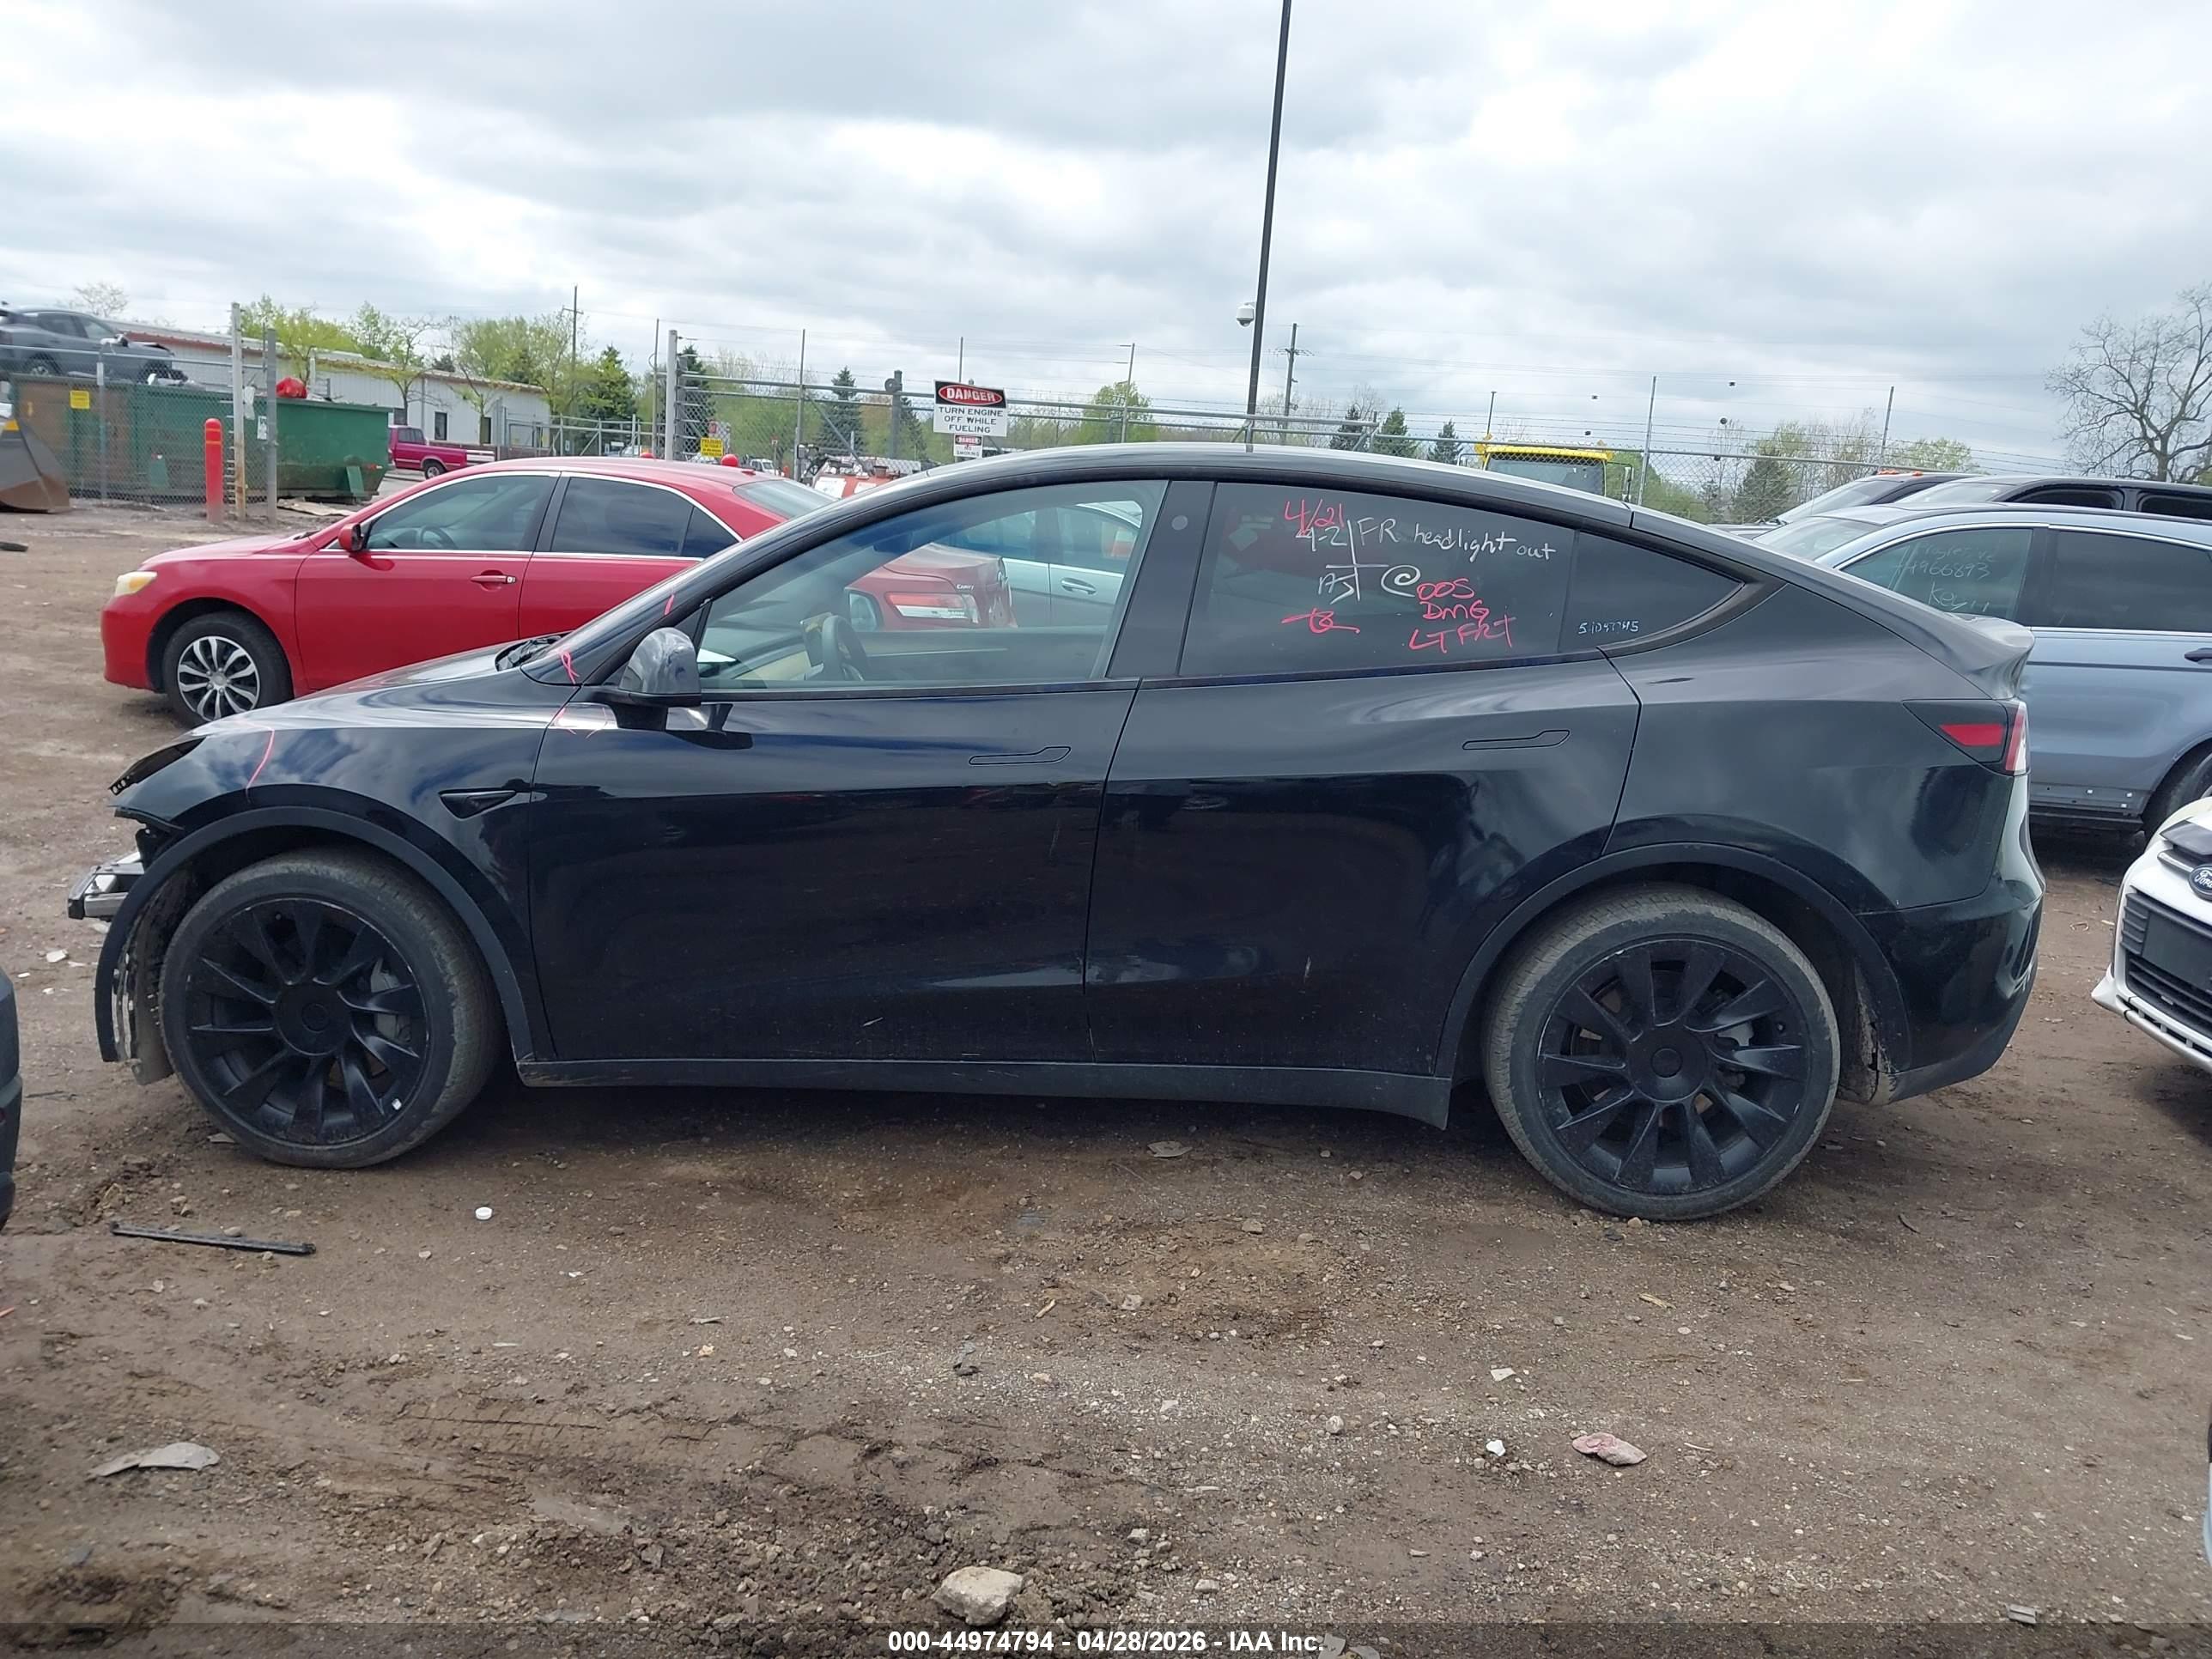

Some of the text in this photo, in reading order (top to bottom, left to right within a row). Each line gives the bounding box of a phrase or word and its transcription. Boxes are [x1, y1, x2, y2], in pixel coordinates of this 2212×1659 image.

[946, 388, 996, 402] DANGER
[939, 406, 1003, 417] TURN ENGINE
[966, 416, 997, 425] WHILE
[949, 424, 991, 433] FUELING
[1414, 524, 1517, 562] headlight
[1516, 543, 1557, 561] out
